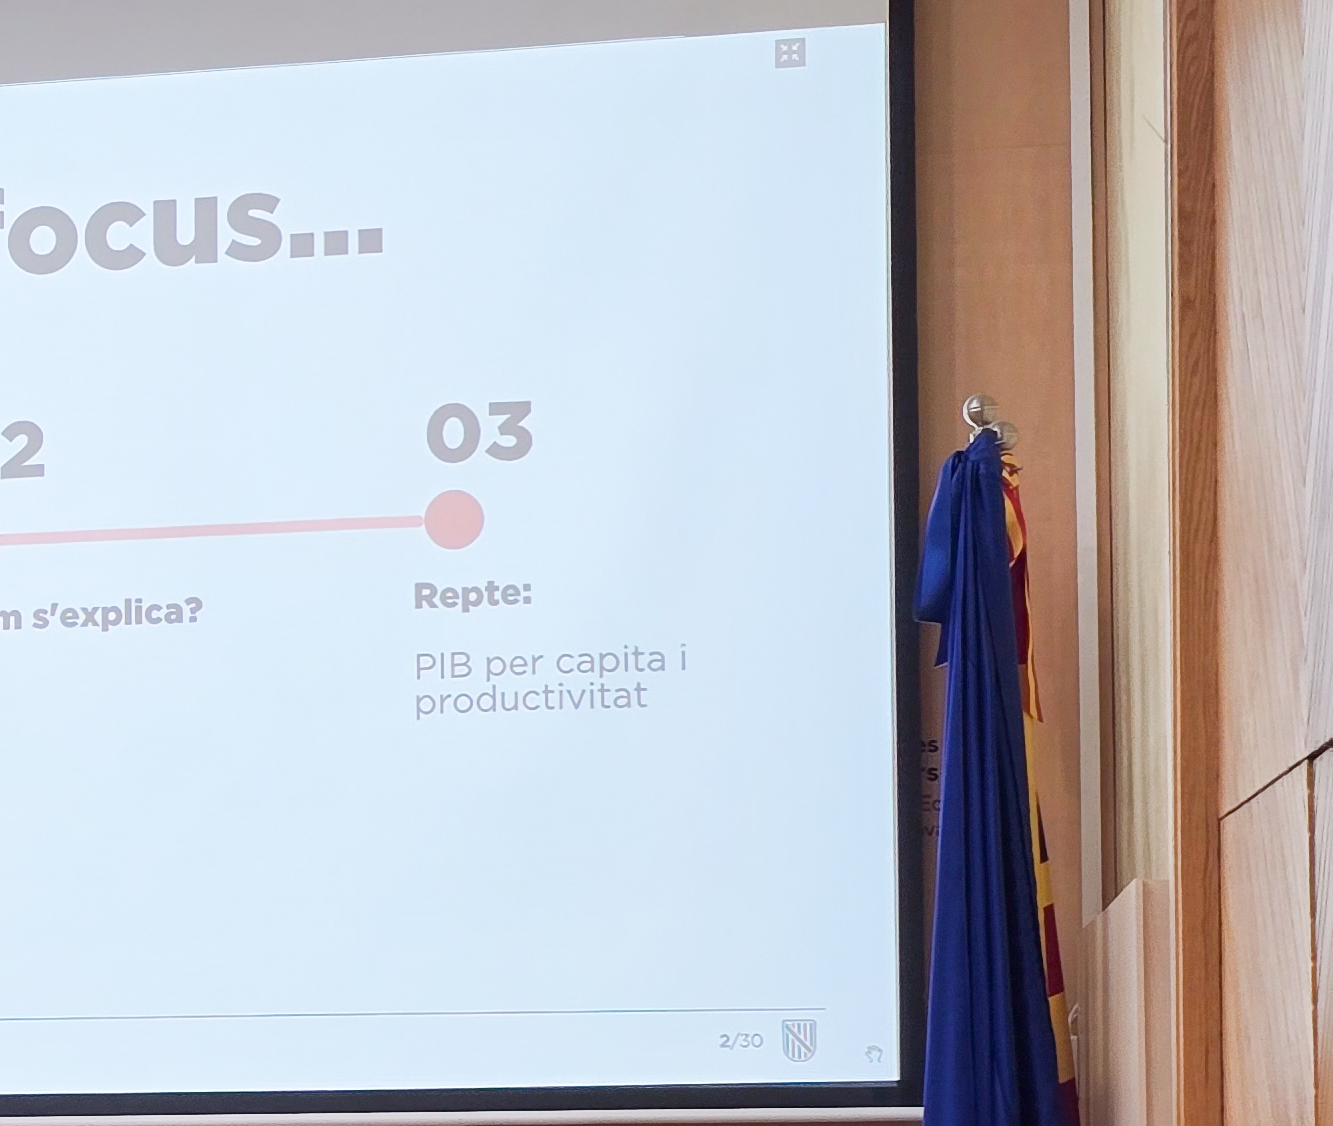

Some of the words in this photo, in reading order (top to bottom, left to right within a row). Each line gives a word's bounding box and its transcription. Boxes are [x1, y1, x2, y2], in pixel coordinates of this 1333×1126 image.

[426, 400, 533, 464] 03
[31, 596, 203, 633] s'explica?
[414, 580, 532, 614] Repte:
[416, 651, 473, 681] PIB
[485, 654, 544, 683] per
[556, 644, 666, 679] capita
[680, 642, 687, 671] i
[415, 682, 648, 721] productivitat
[719, 1032, 764, 1051] 2/30
